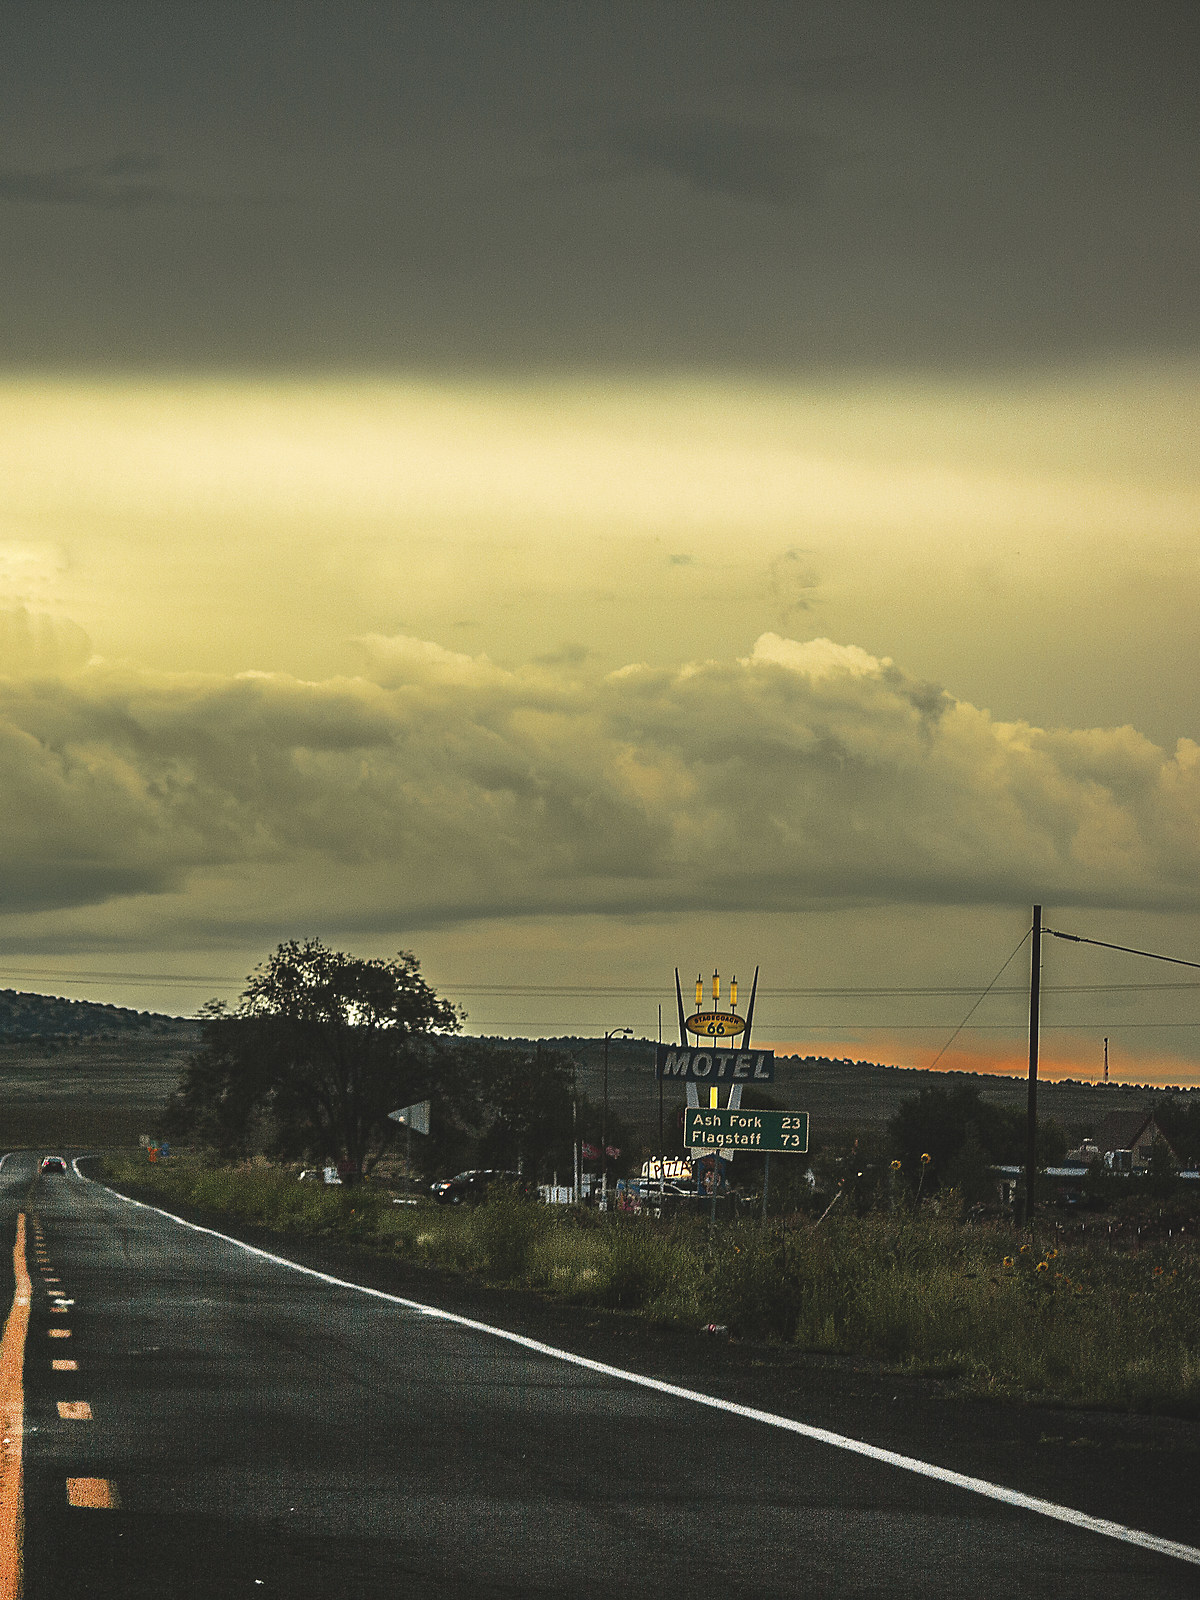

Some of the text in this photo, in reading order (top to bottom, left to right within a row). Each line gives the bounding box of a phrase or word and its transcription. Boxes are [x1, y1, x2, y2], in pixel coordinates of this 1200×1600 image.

[707, 1022, 725, 1035] 66
[663, 1052, 770, 1079] MOTEL
[693, 1114, 801, 1129] Ash Fork 23
[692, 1131, 800, 1147] Flagstaff 73
[654, 1161, 692, 1178] PIZZA
